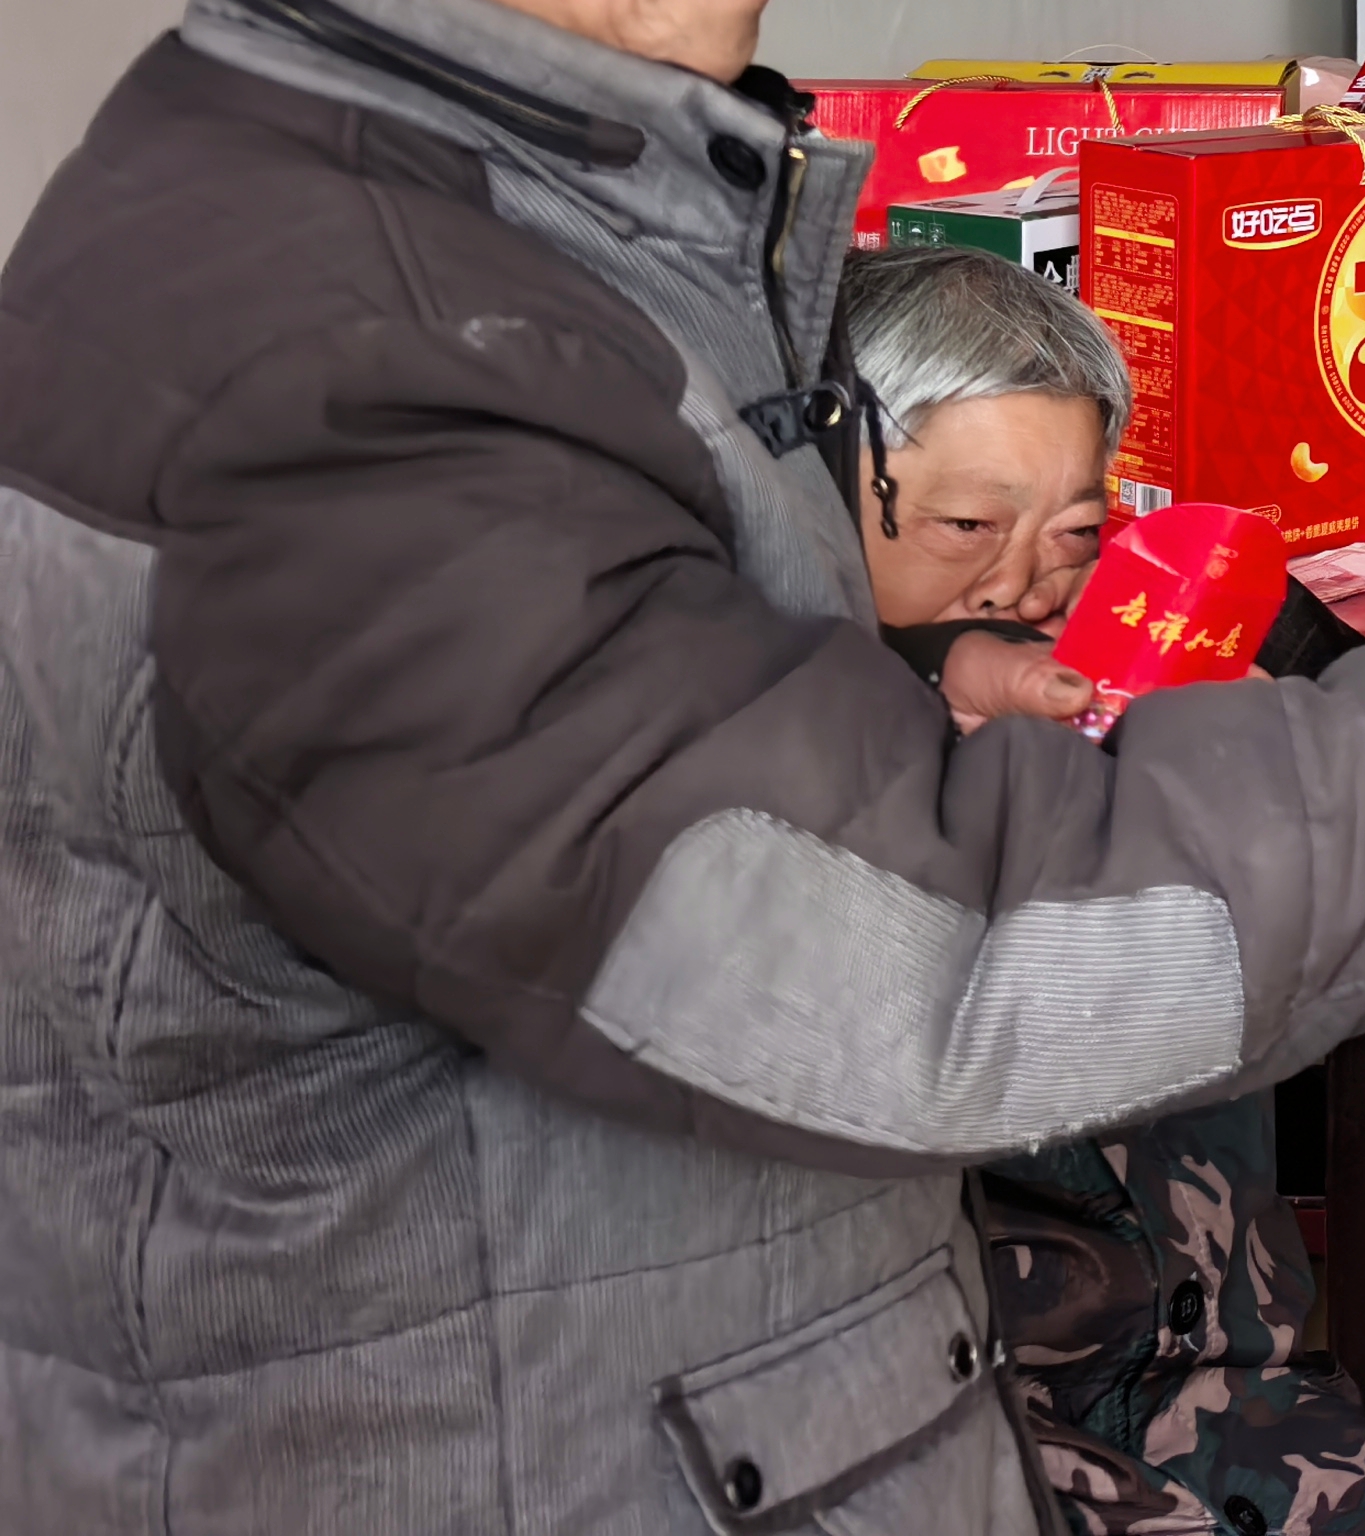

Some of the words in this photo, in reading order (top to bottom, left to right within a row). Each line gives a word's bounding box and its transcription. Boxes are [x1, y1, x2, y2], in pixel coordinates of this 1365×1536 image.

[1231, 204, 1316, 239] 好吃点
[1111, 591, 1243, 658] 吉祥如意
